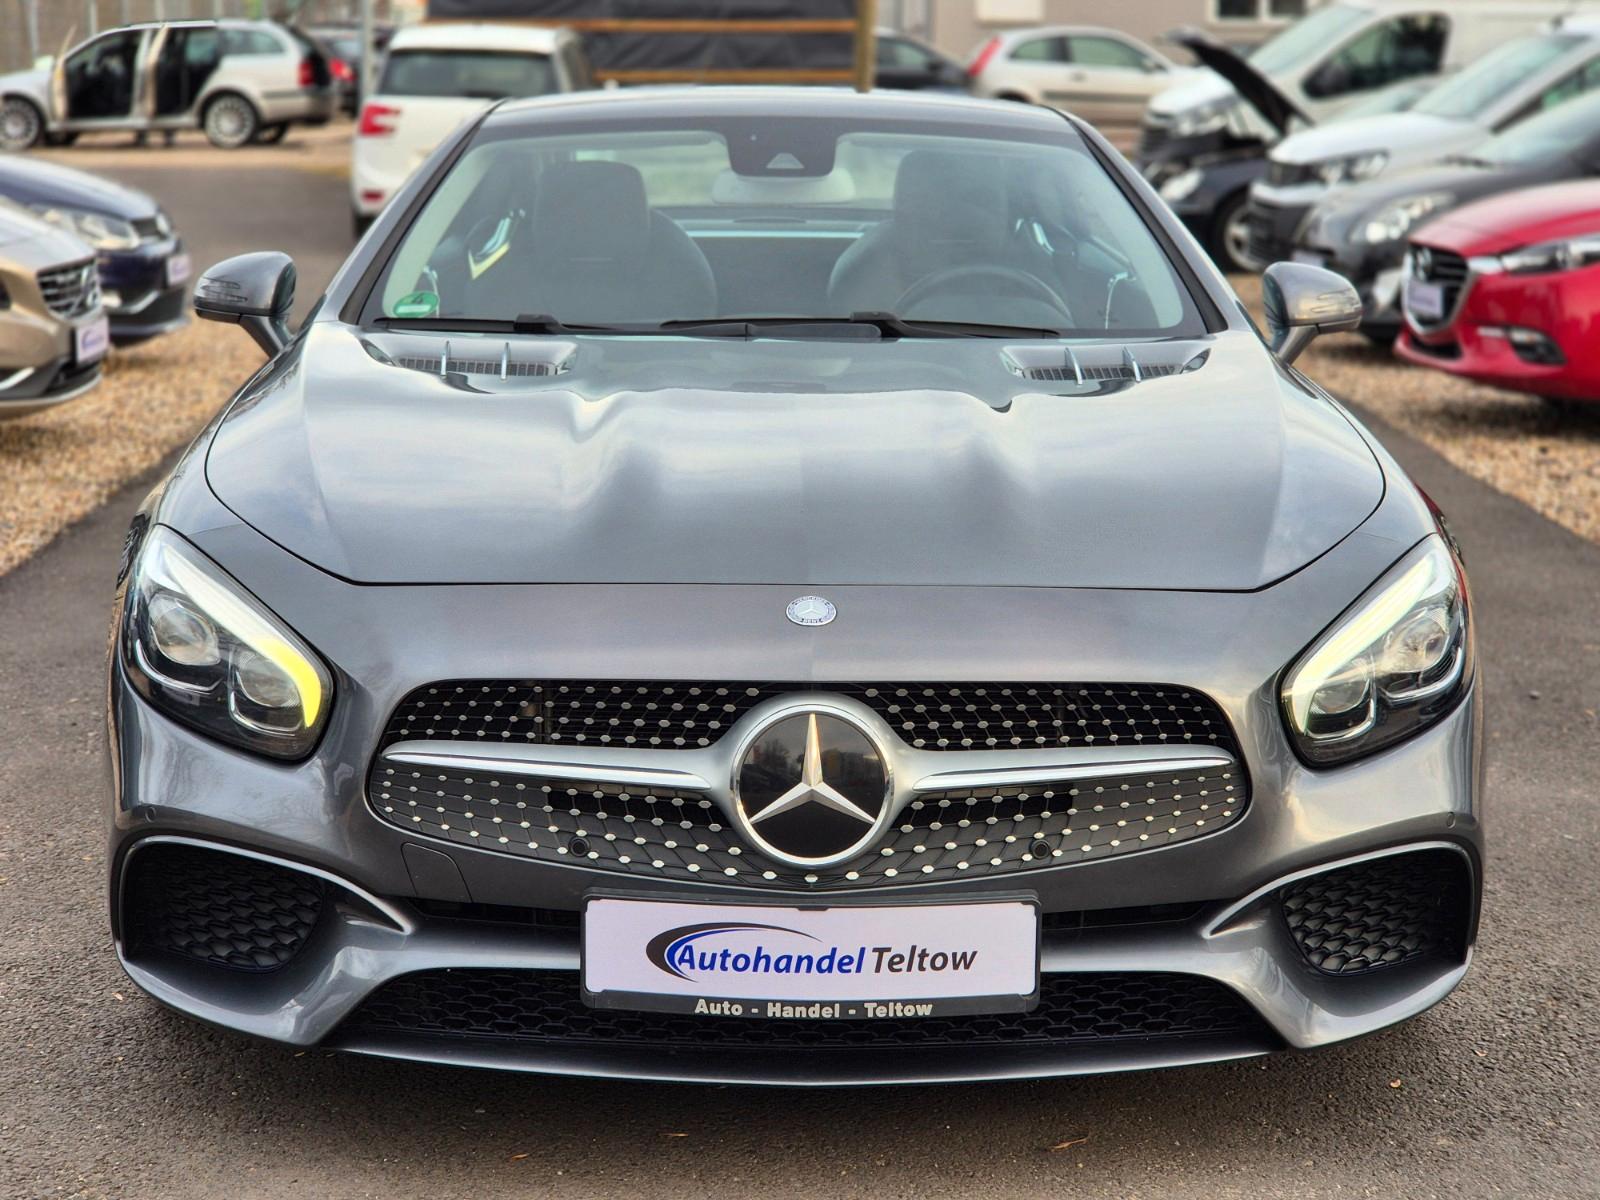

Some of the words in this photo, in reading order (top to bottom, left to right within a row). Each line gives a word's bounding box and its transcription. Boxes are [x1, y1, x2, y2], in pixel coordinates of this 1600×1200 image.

[678, 945, 866, 974] Autohandel
[872, 945, 978, 974] Teltow
[694, 998, 743, 1016] Auto
[767, 1002, 840, 1018] Handel
[864, 1002, 933, 1018] Teltow
